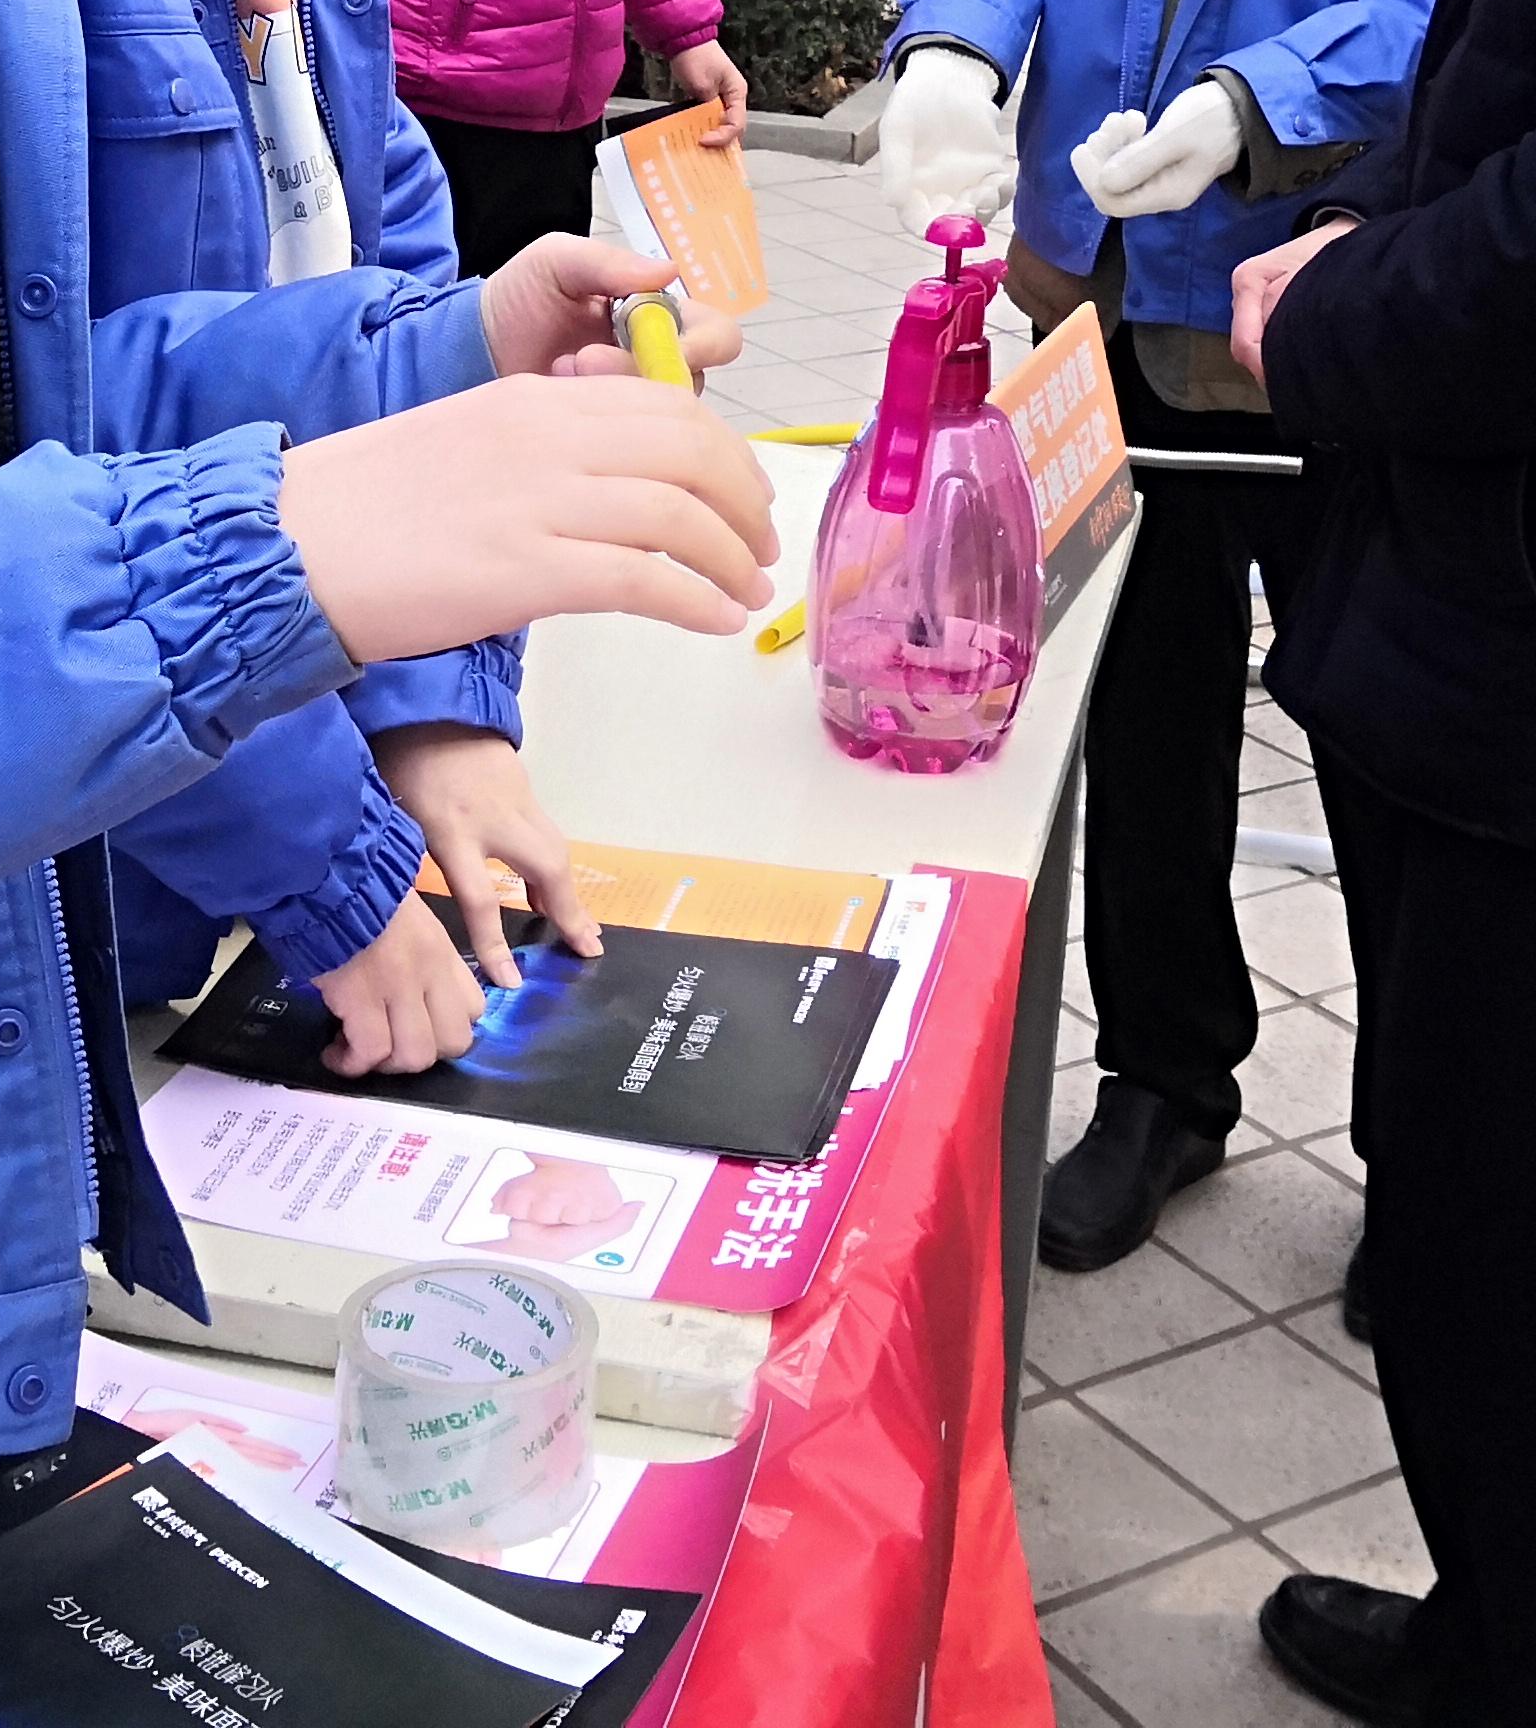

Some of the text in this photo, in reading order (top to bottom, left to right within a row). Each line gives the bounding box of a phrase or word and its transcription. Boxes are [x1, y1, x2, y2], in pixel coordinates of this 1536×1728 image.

[209, 1547, 270, 1588] PERCEN
[46, 1596, 267, 1728] 匀火爆炒·美味面
